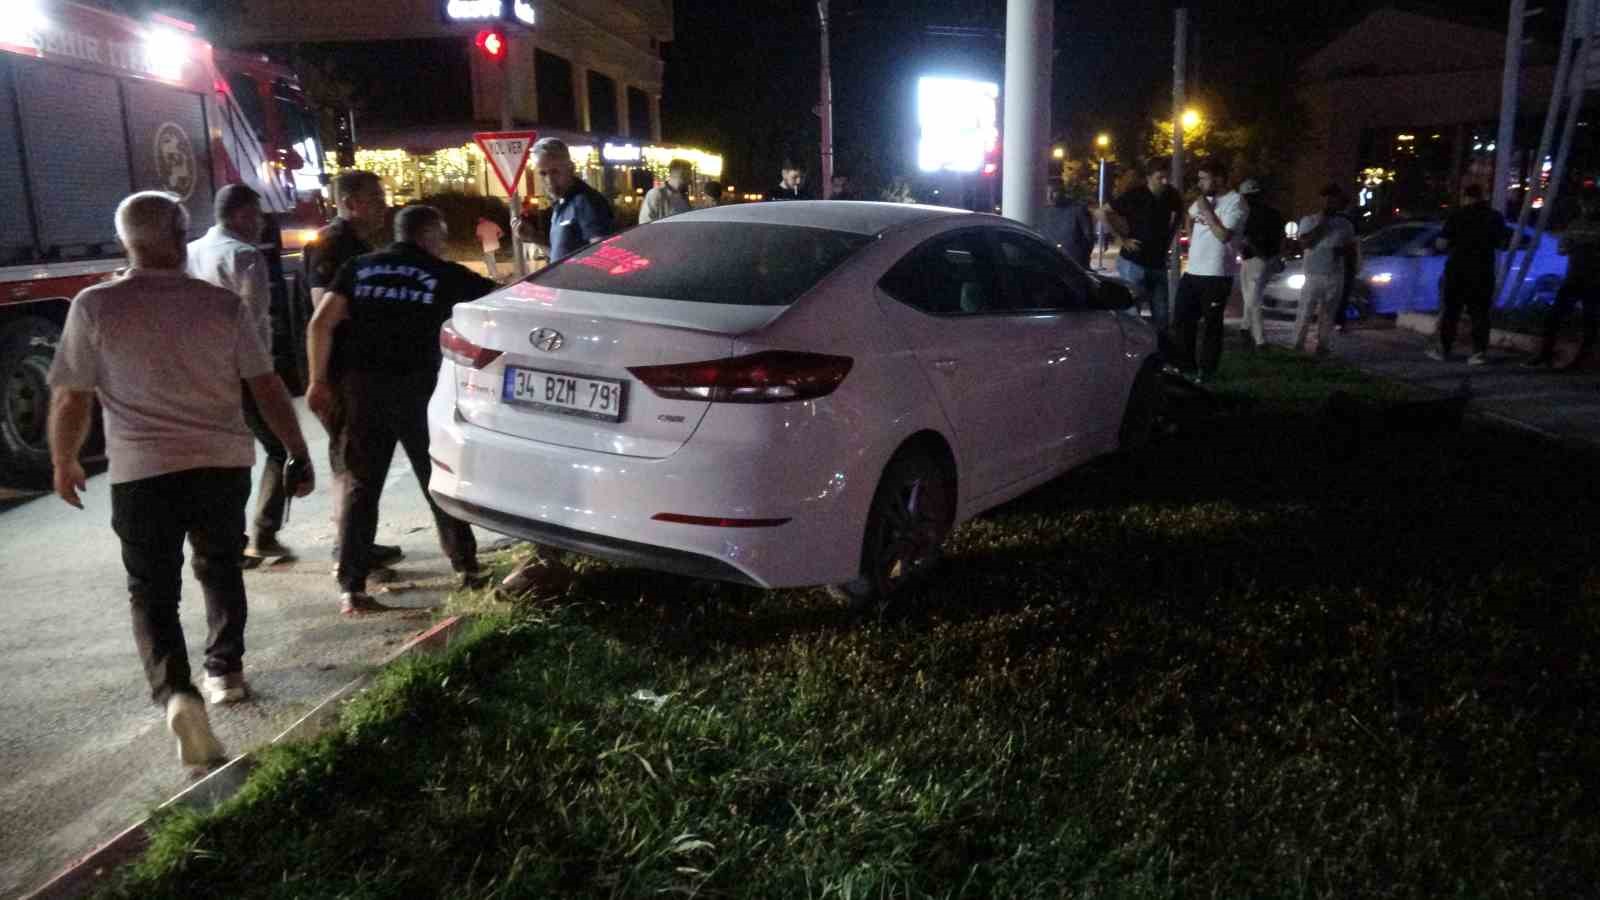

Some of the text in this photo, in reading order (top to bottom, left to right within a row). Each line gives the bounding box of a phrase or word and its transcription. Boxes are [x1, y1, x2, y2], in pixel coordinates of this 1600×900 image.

[507, 141, 523, 155] VER
[356, 264, 438, 290] MALATYA
[516, 371, 534, 397] 34
[545, 376, 577, 405] BZM
[589, 382, 618, 411] 791
